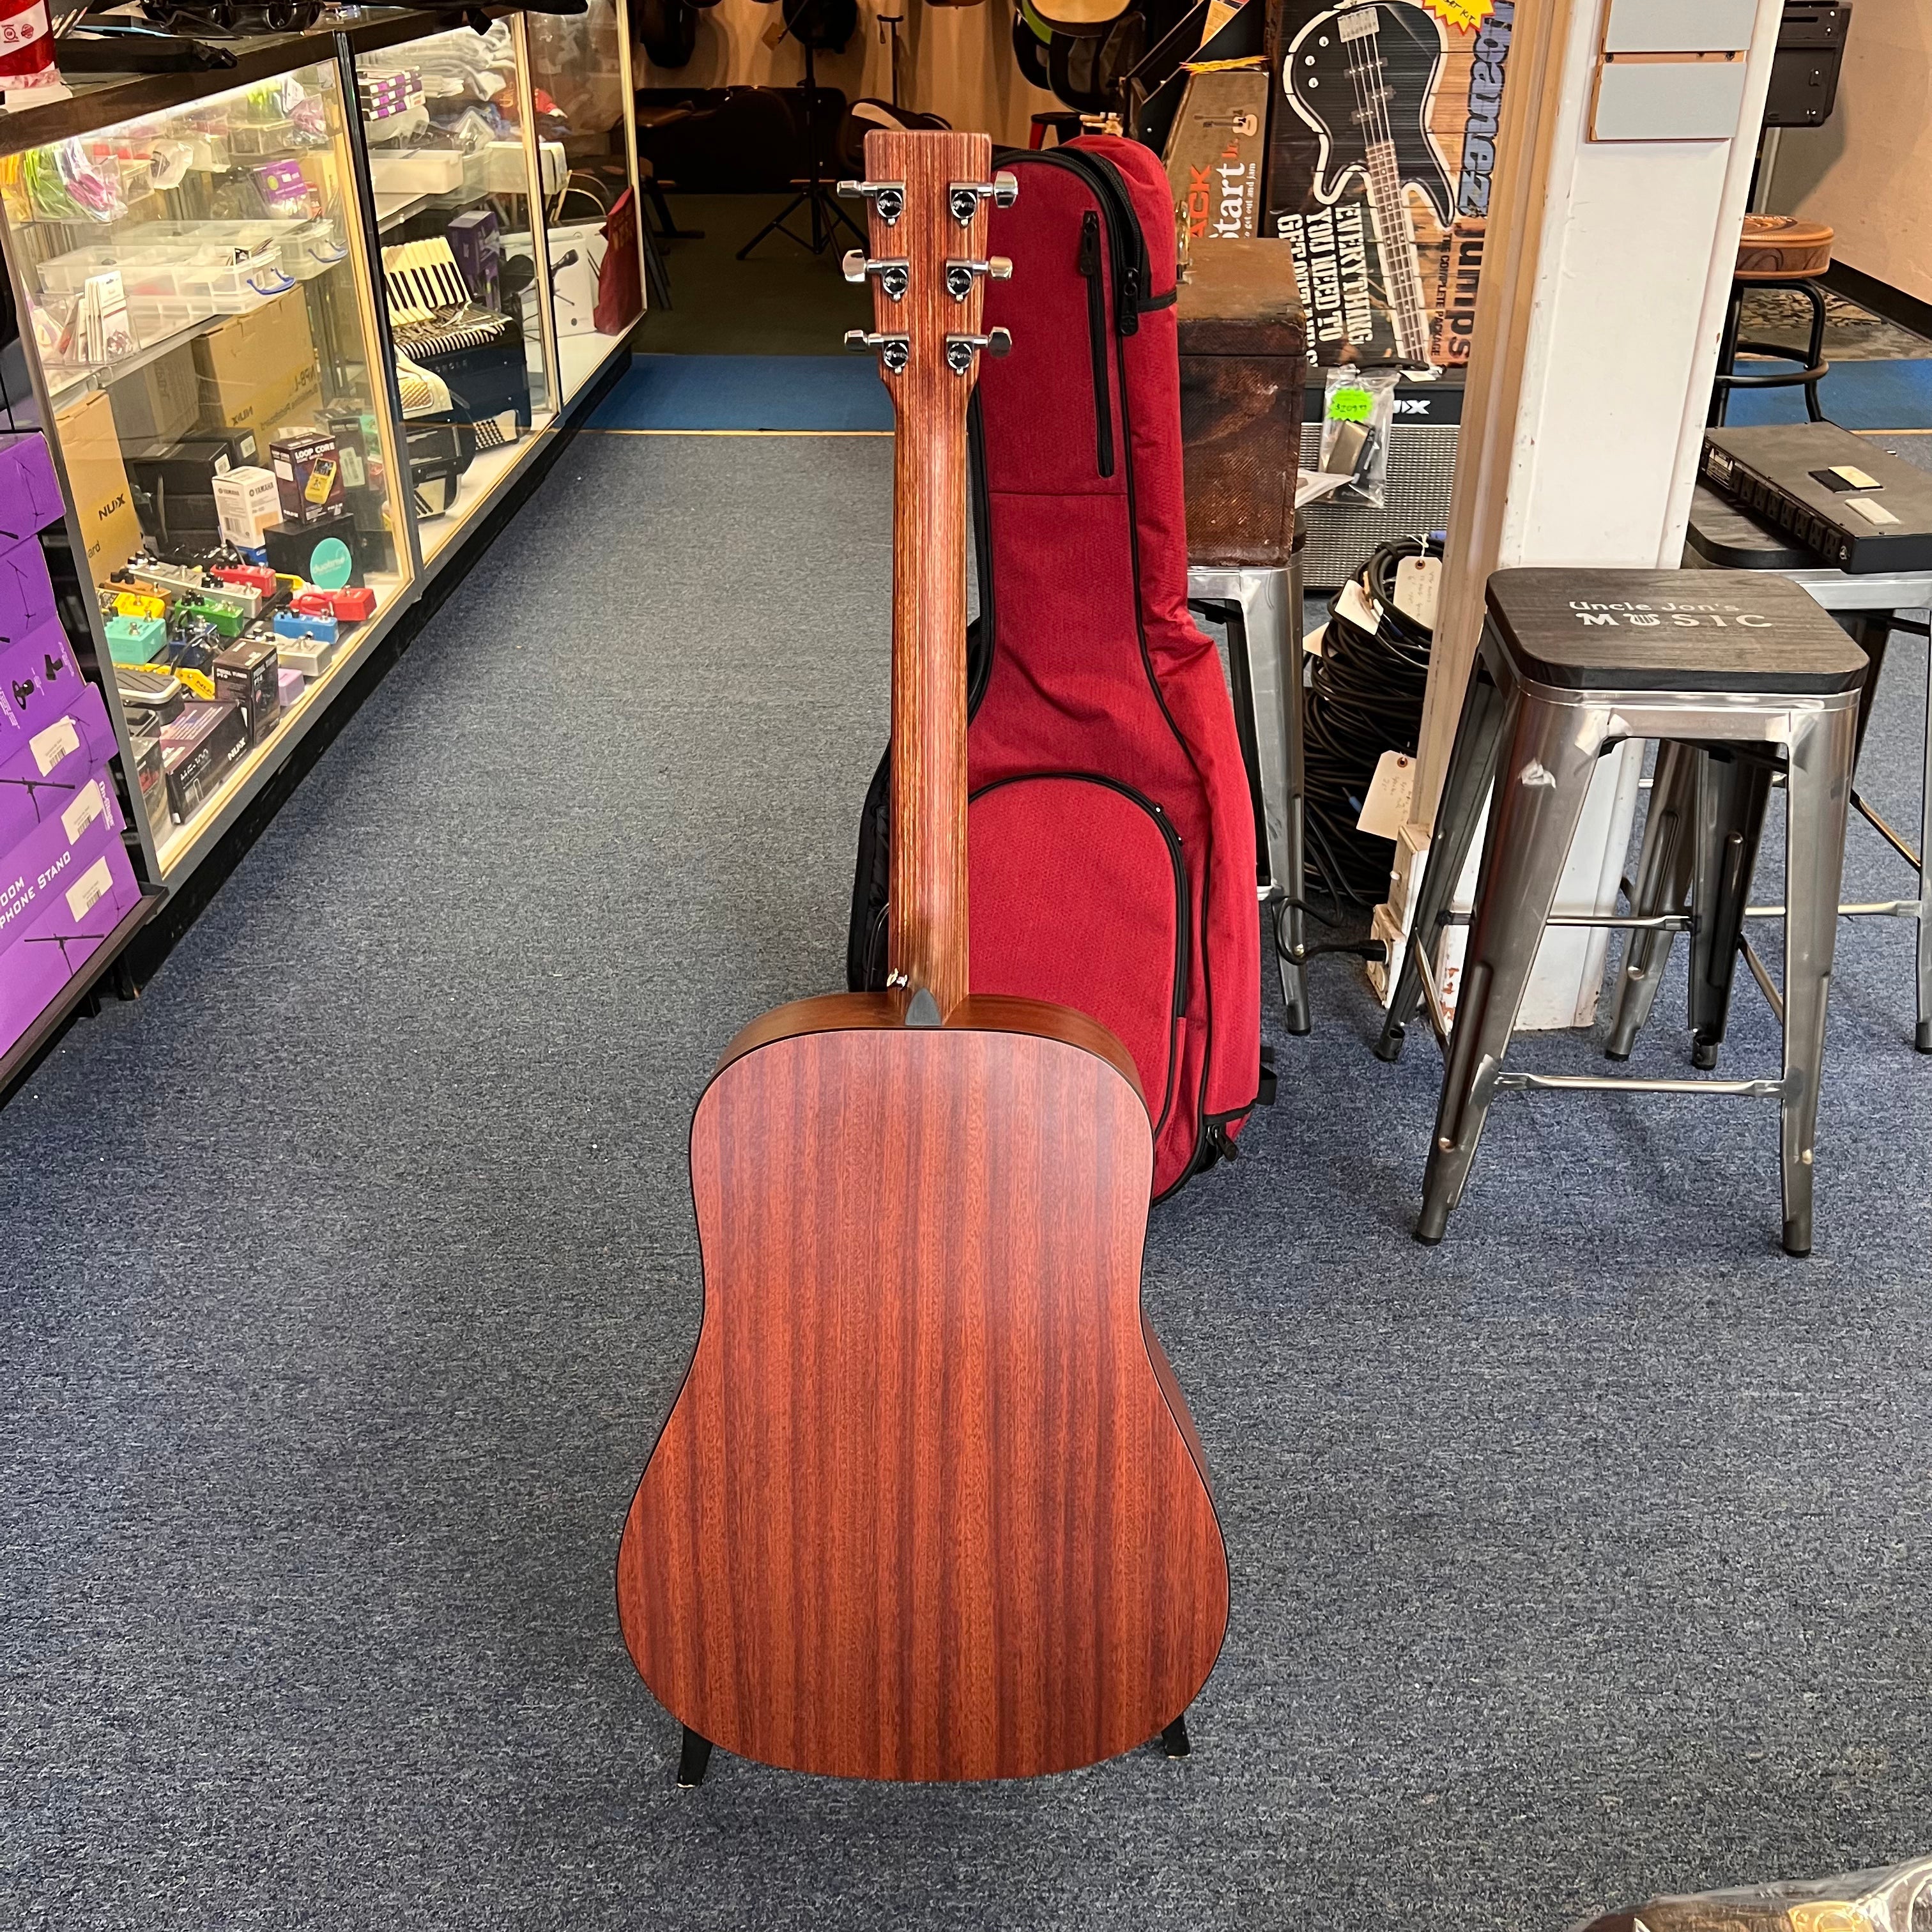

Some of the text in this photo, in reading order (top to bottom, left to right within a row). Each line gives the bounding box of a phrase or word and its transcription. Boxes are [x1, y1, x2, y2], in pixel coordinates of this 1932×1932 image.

[1306, 206, 1335, 253] YOU
[1311, 254, 1341, 310] NEED
[1335, 202, 1373, 345] EVERYTHING
[1436, 255, 1450, 308] COMPLETE
[1317, 310, 1344, 342] TO
[1430, 310, 1446, 356] PACKAGE
[295, 448, 314, 460] LOOP
[315, 442, 335, 455] CORE
[256, 482, 274, 496] YAMAHA
[98, 493, 125, 521] NUX
[1569, 601, 1740, 611] Uncle Jon's
[1575, 613, 1773, 627] MUSIC
[227, 737, 246, 762] NUX
[37, 851, 71, 890] STAND
[0, 877, 25, 907] OOM
